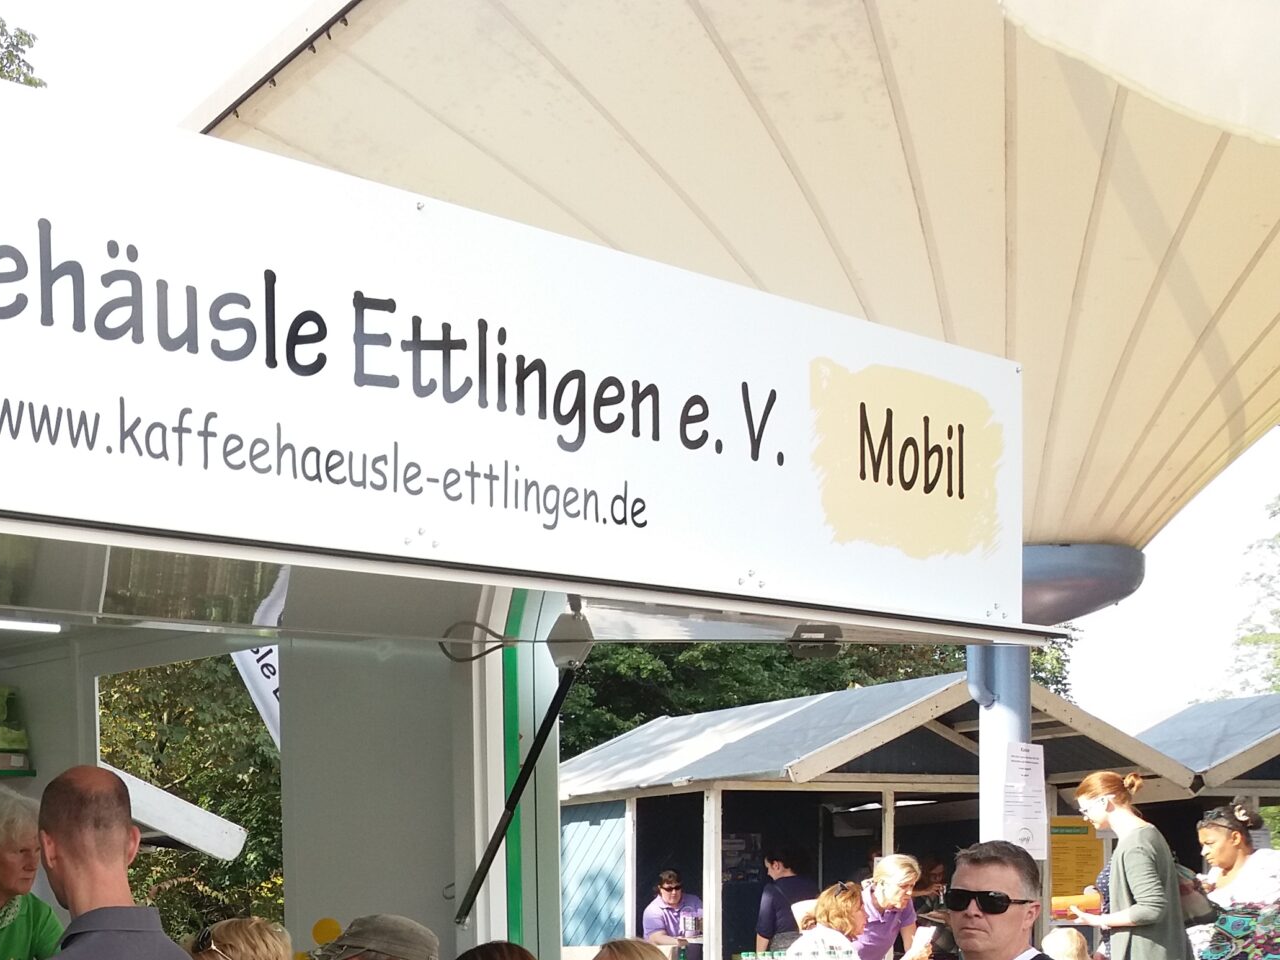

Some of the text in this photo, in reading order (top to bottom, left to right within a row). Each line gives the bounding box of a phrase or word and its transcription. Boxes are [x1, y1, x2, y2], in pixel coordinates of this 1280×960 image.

[352, 290, 661, 453] Ettlingen
[679, 394, 724, 455] e.
[741, 381, 786, 467] V.
[859, 401, 966, 500] Mobil
